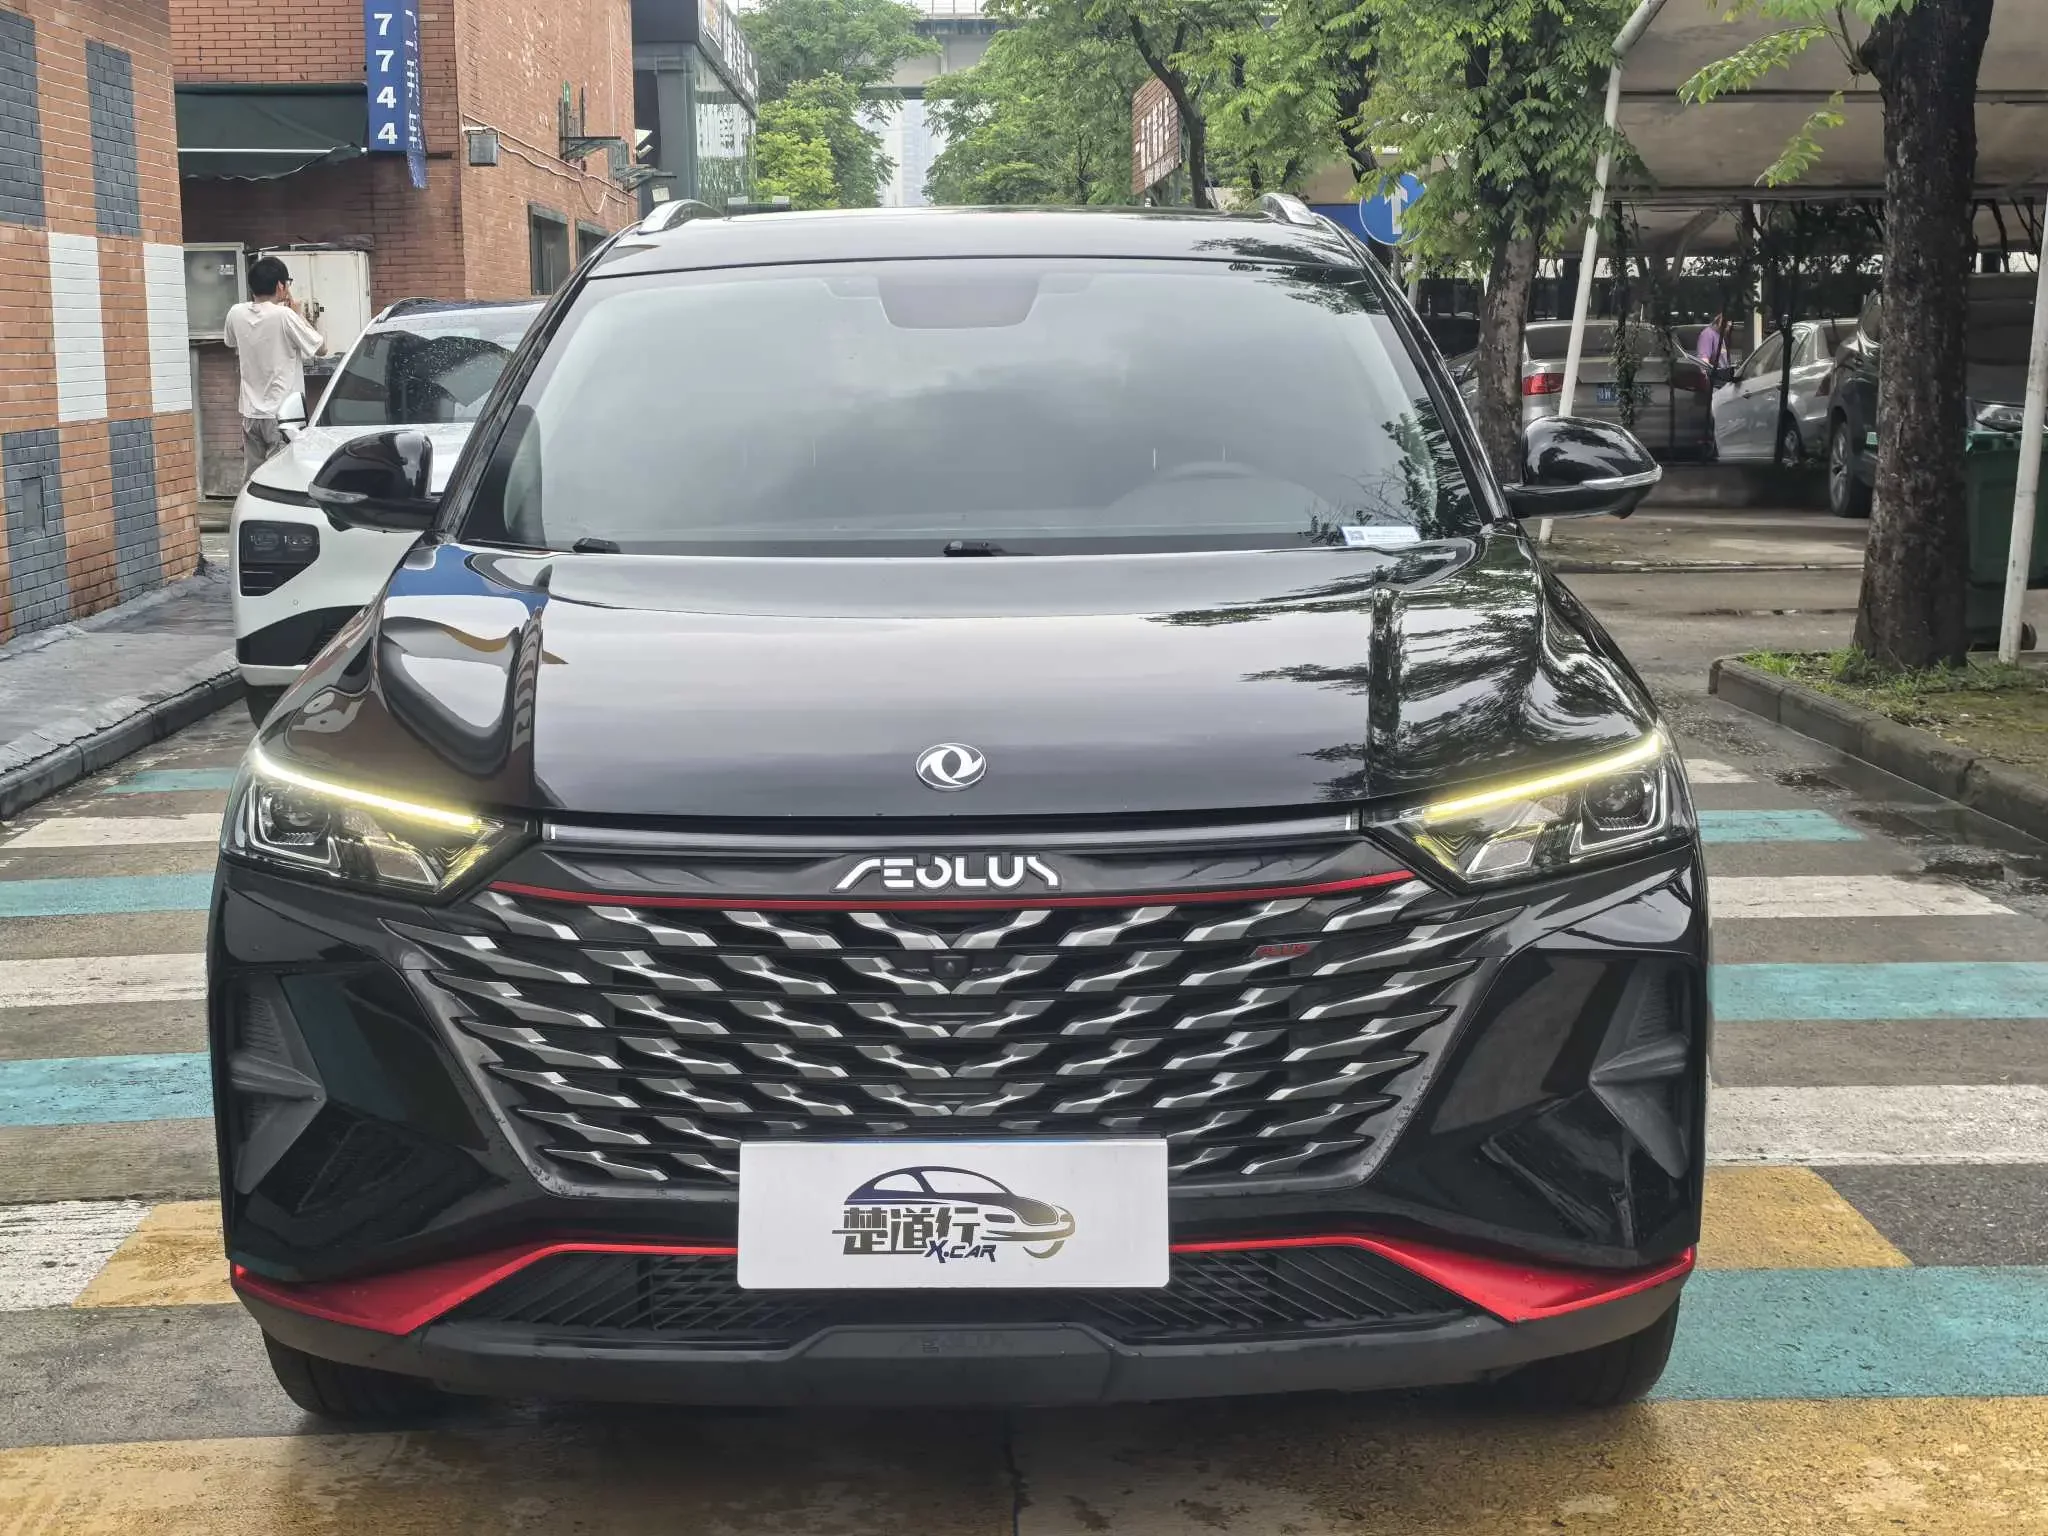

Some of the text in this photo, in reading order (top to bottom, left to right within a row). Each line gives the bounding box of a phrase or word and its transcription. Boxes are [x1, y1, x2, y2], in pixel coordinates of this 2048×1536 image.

[373, 13, 398, 145] 7744
[833, 856, 1060, 890] AEOLUS
[832, 1207, 980, 1255] 楚道行
